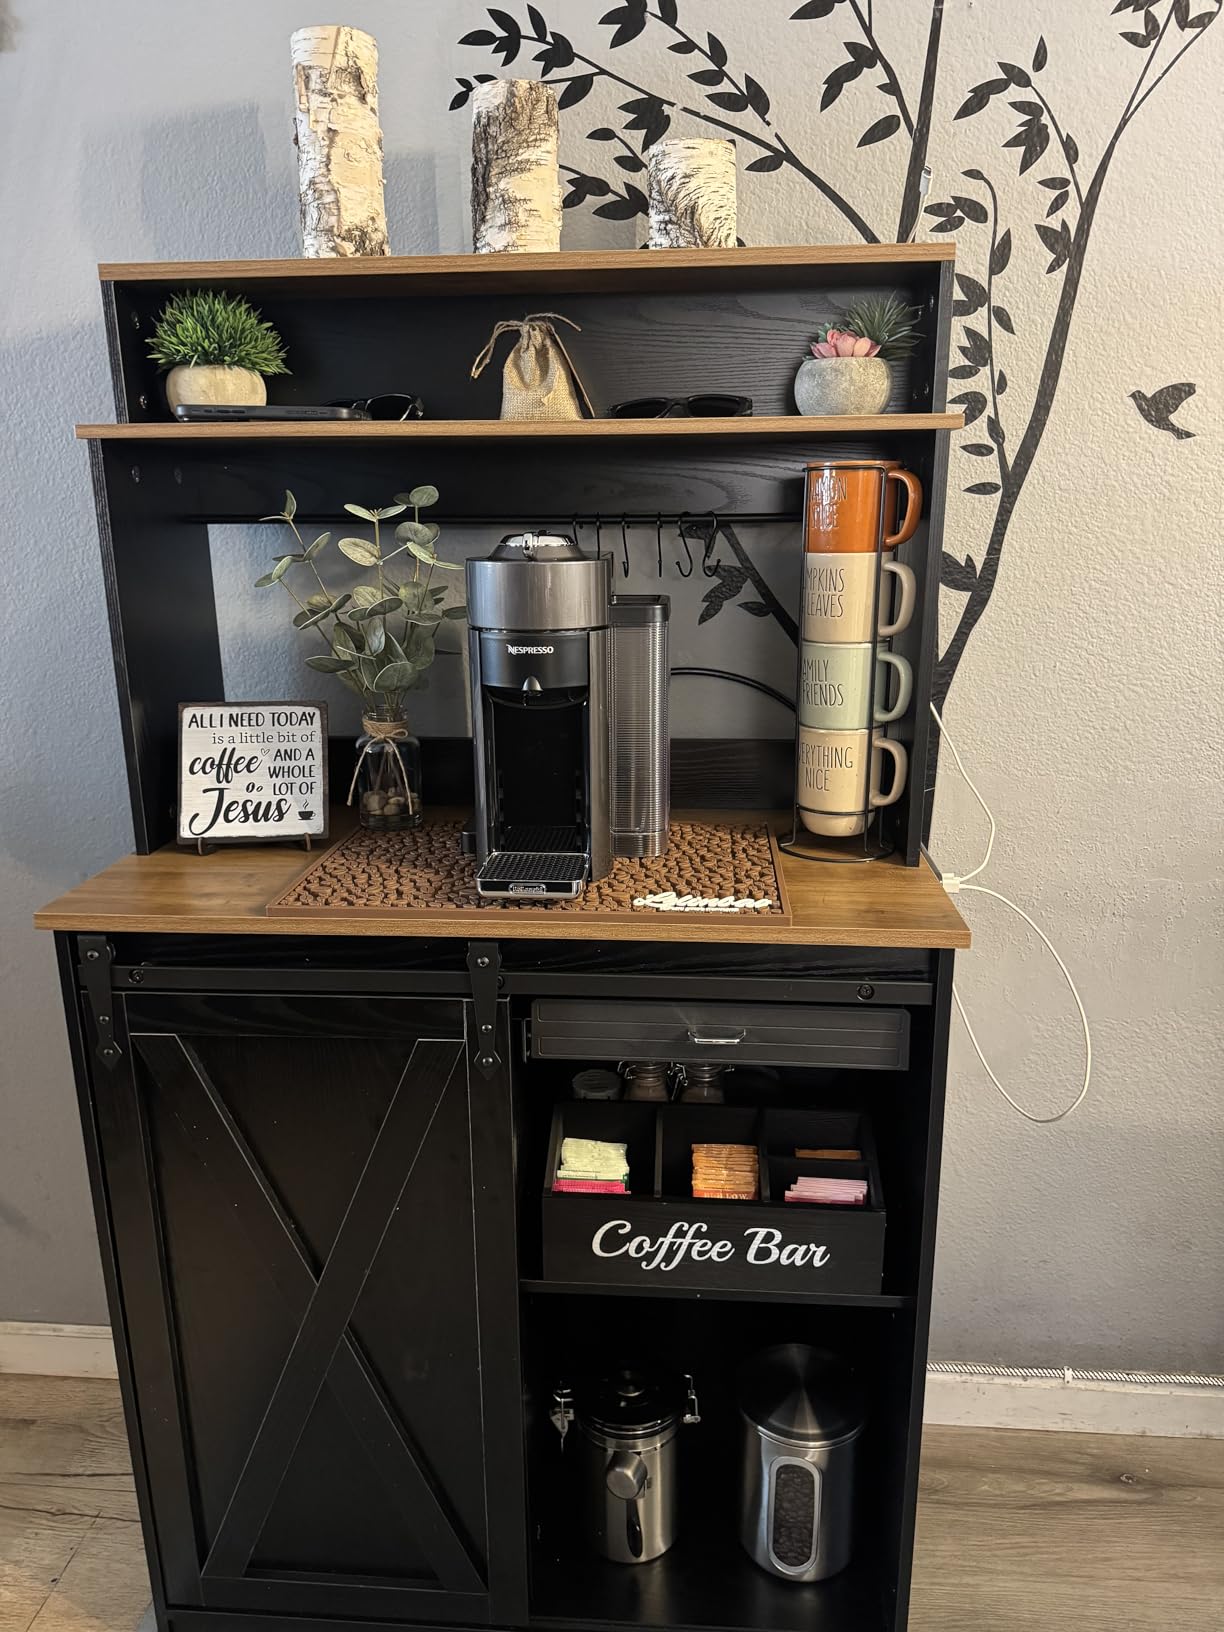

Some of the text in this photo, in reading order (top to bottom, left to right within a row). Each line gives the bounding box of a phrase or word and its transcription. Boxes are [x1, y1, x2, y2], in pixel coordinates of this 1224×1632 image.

[806, 567, 845, 592] MPKINS
[807, 592, 844, 618] LEAVES
[506, 644, 554, 655] NESPRESSO
[802, 658, 829, 682] AMILY
[188, 711, 316, 728] ALL I NEED TODAY
[211, 731, 316, 744] is a little bit of
[188, 747, 263, 784] coffee
[273, 748, 315, 762] AND A
[800, 742, 853, 768] ERYTHING
[268, 765, 316, 779] WHOLE
[805, 766, 830, 791] NICE
[273, 781, 317, 796] LOT OF
[188, 787, 292, 836] Jesus
[592, 1220, 830, 1271] Coffee Bar
